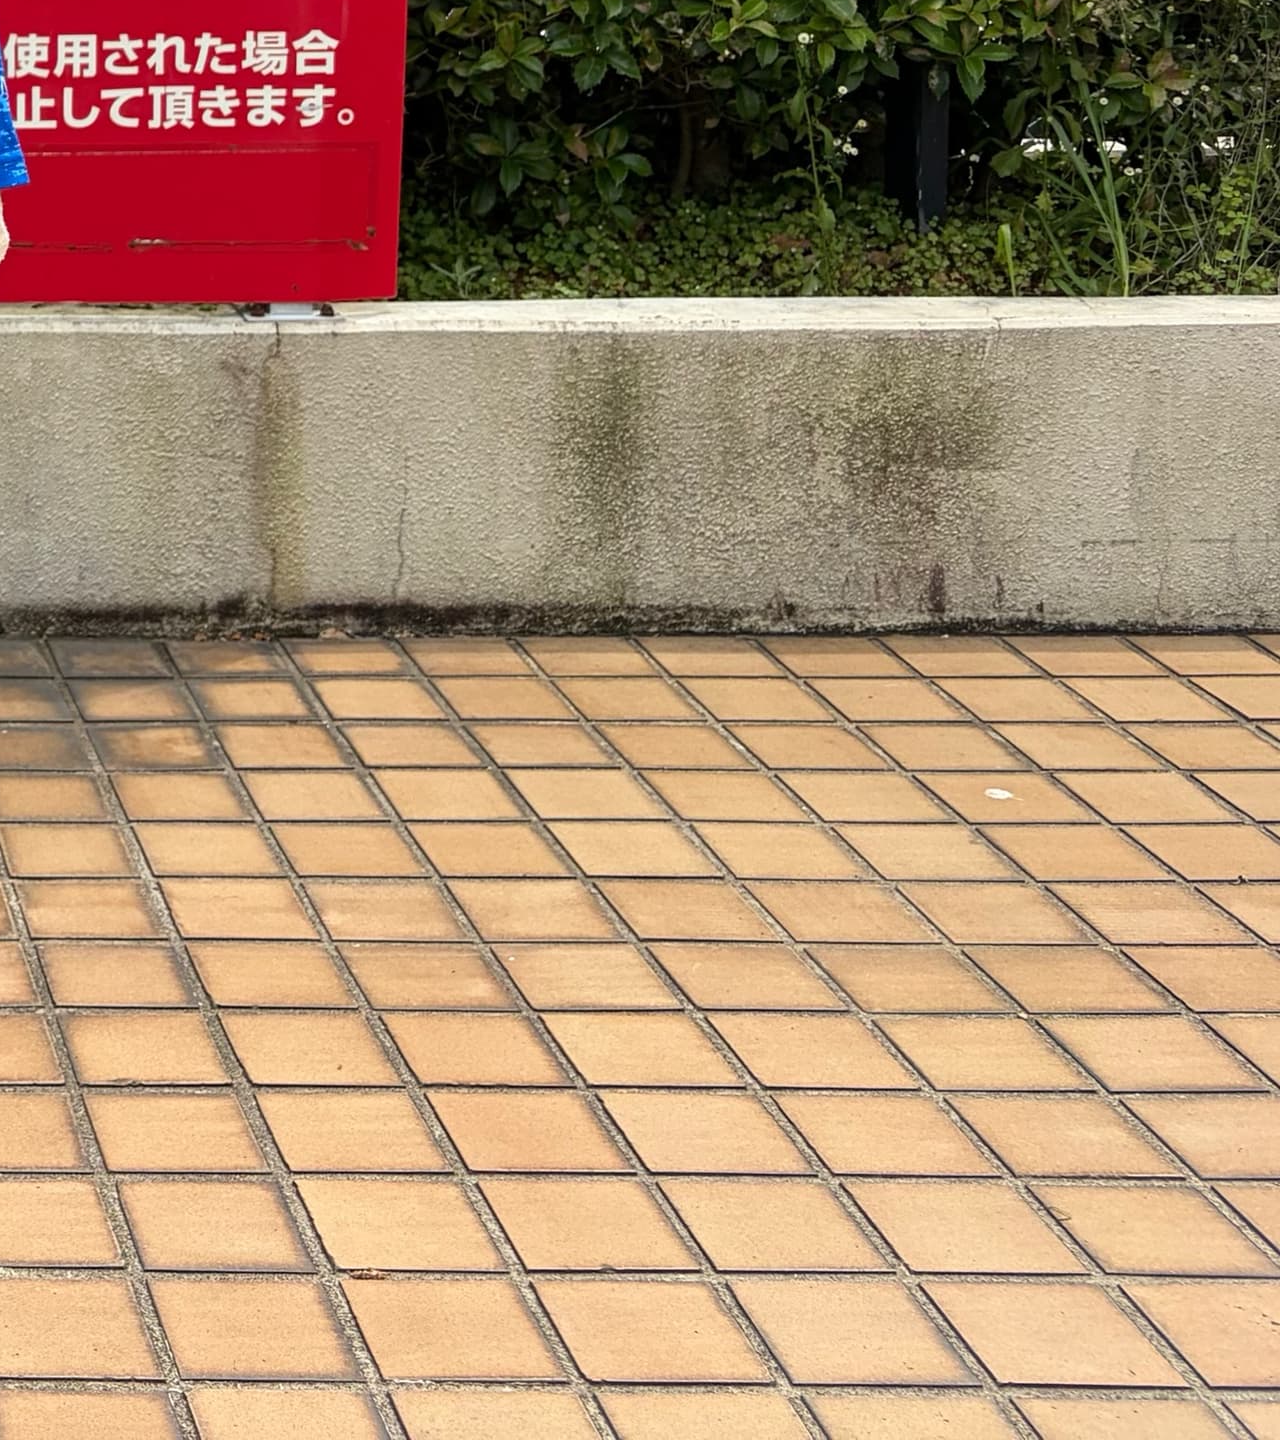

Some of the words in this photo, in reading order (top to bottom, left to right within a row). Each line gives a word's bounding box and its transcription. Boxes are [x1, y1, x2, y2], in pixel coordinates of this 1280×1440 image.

[3, 29, 341, 79] 使用された場合
[13, 84, 356, 131] 止して頂きます。
